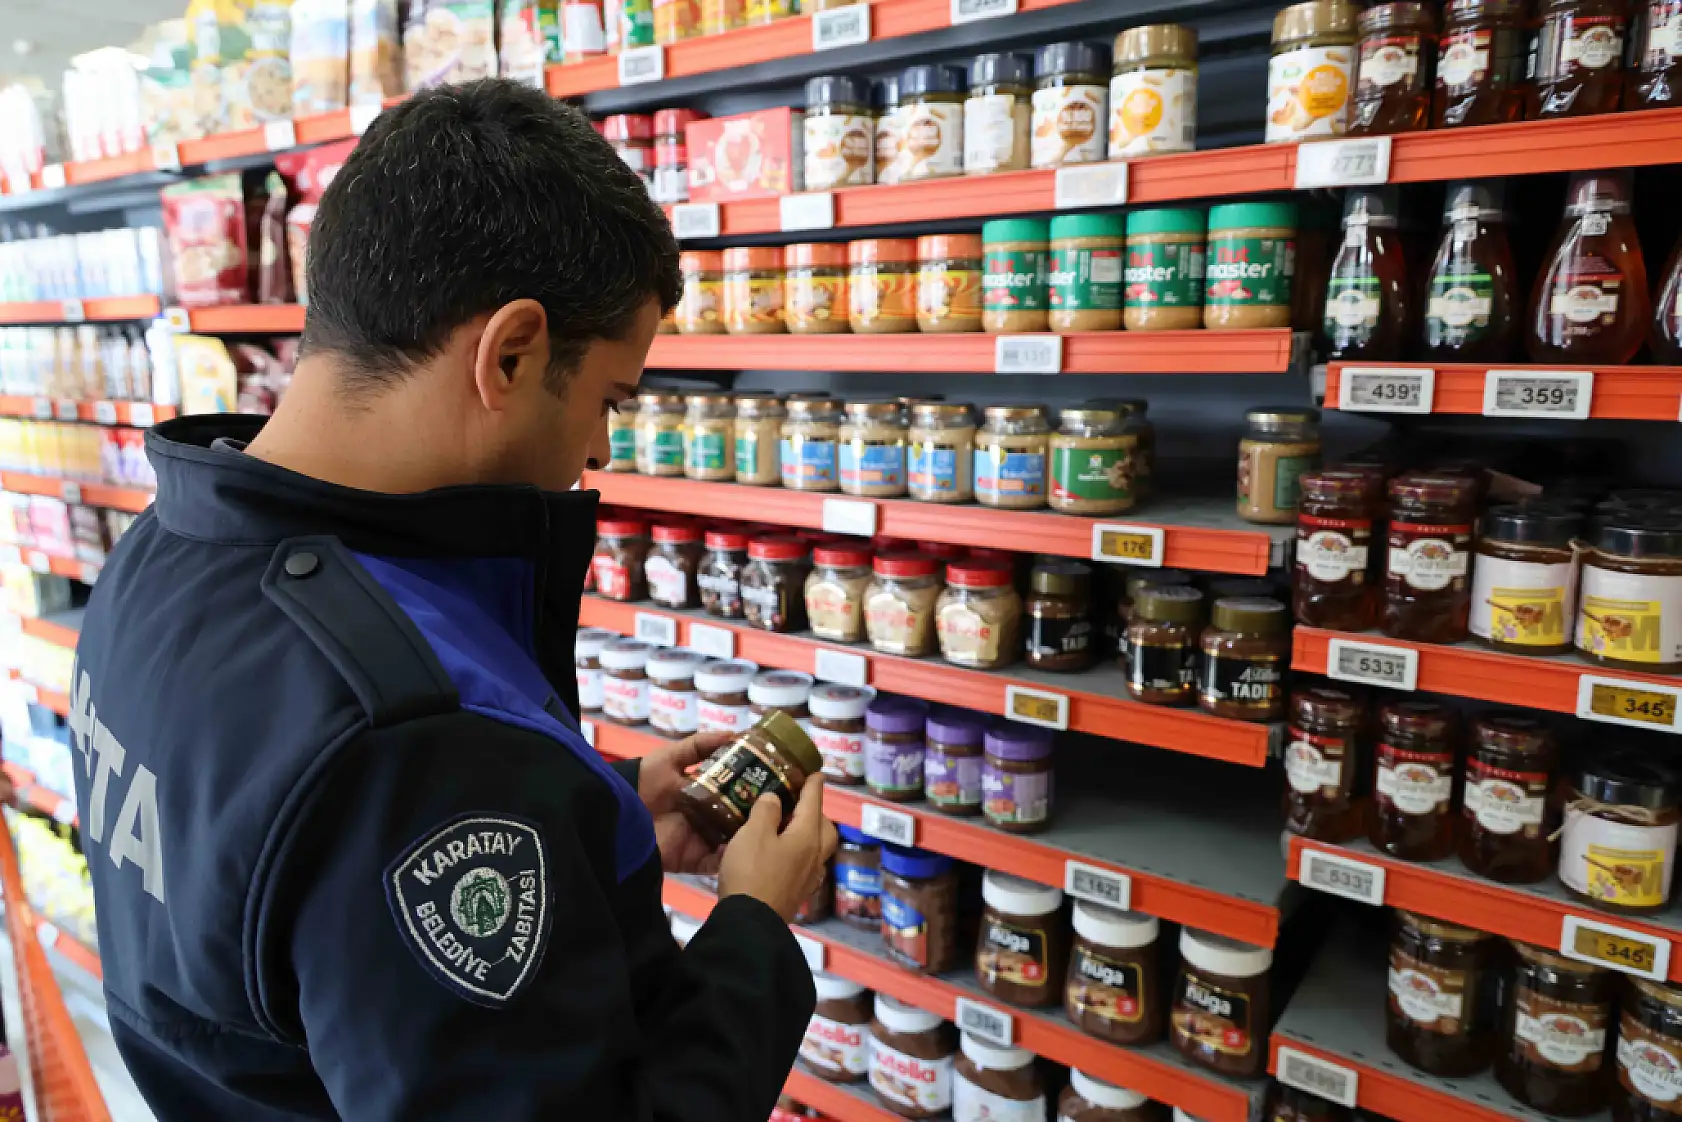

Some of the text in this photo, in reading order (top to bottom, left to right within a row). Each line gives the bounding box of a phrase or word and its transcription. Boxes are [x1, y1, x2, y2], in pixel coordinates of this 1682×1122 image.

[1372, 384, 1409, 400] 439
[1521, 387, 1564, 405] 359
[1360, 657, 1394, 675] 533
[1623, 697, 1665, 717] 345
[412, 831, 523, 886] KARATAY
